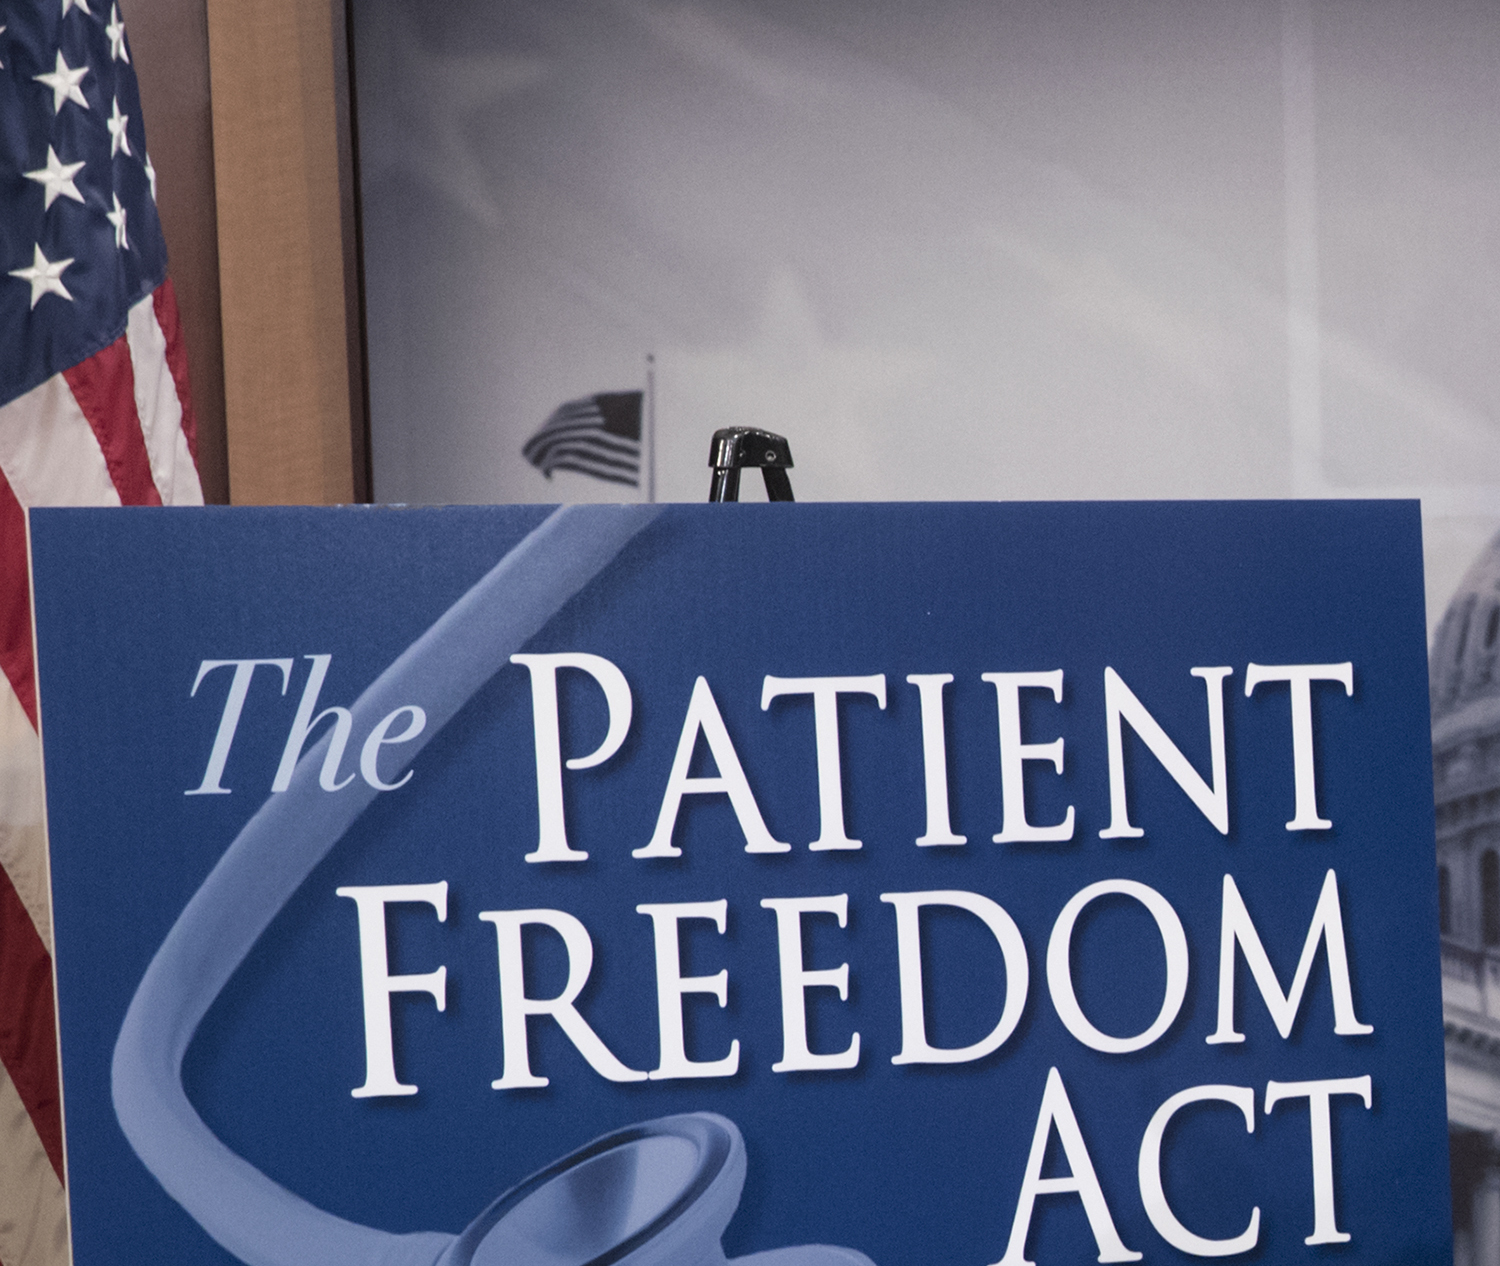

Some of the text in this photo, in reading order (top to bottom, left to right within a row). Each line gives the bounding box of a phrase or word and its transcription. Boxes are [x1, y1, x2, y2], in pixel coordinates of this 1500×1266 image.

[184, 653, 1354, 863] The PATIENT
[336, 869, 1374, 1100] FREEDOM
